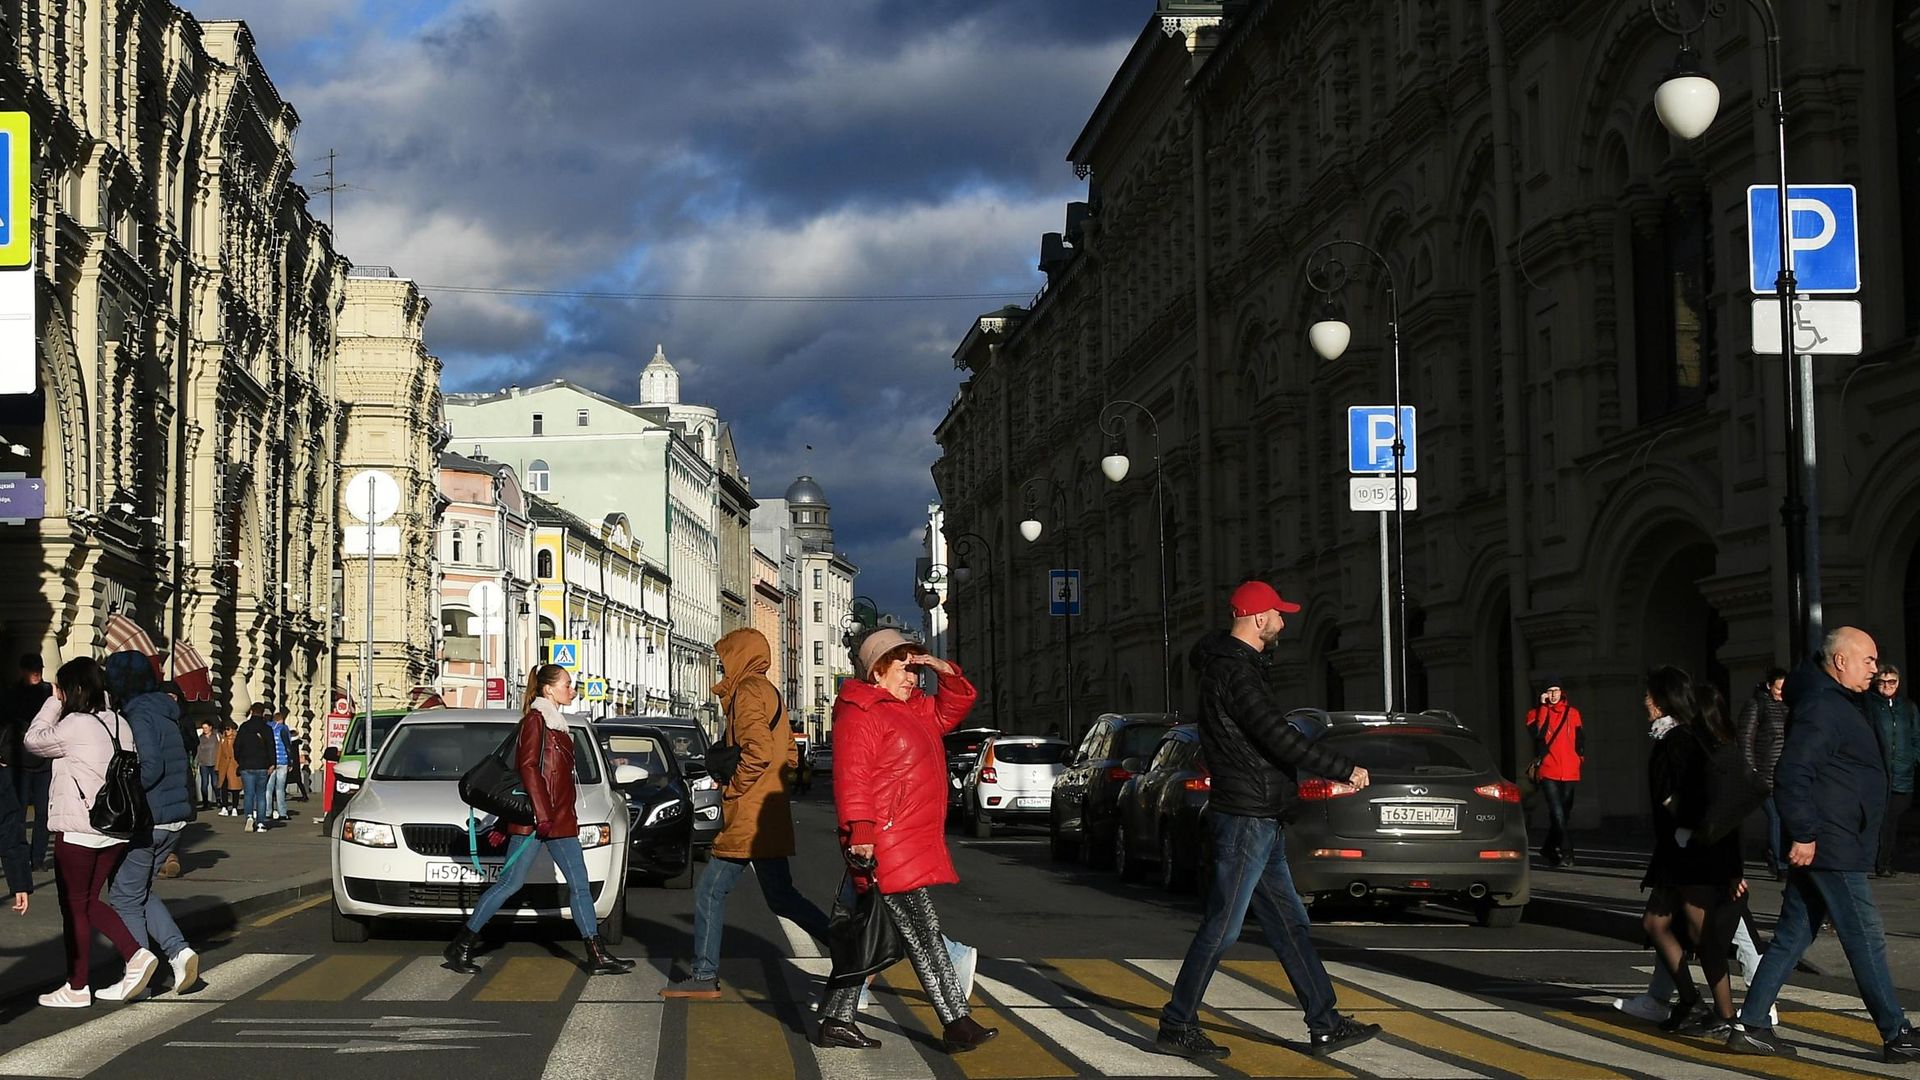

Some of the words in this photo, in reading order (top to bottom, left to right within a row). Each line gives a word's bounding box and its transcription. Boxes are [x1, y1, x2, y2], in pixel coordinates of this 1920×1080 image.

[1786, 198, 1837, 272] P
[1368, 414, 1397, 465] P
[1358, 489, 1368, 498] 10
[1372, 488, 1384, 500] 15
[1385, 808, 1432, 821] Т637ЕН
[1434, 808, 1451, 818] 777
